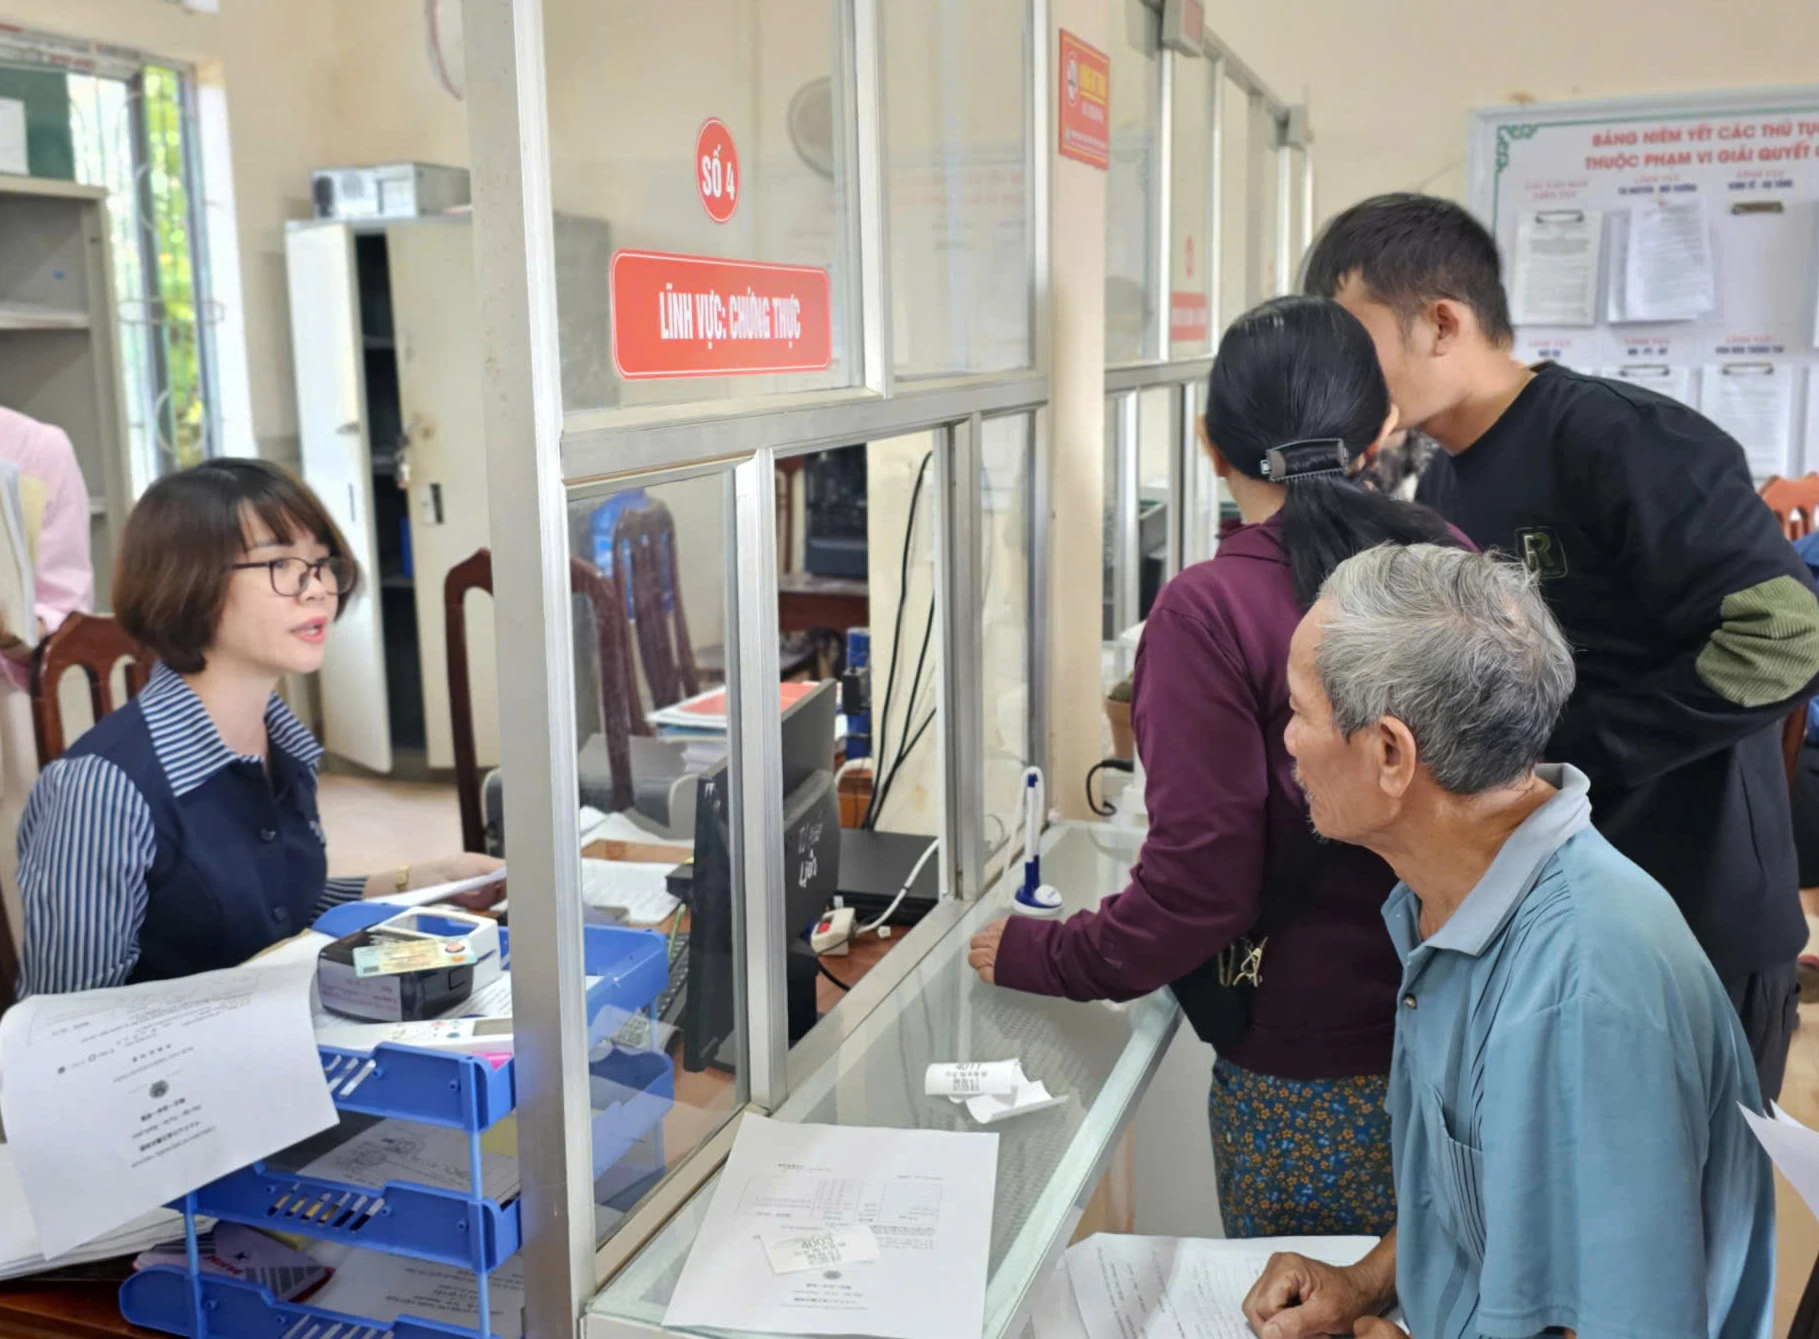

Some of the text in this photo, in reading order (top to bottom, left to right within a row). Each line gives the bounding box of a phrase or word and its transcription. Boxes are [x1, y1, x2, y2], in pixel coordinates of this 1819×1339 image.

[1591, 128, 1638, 147] BẢNG
[1687, 123, 1713, 141] YẾT
[1717, 121, 1756, 139] CÁC
[1762, 118, 1793, 138] THỦ
[702, 144, 735, 200] SỐ 4
[1584, 151, 1639, 171] THUỘC
[1643, 151, 1692, 169] PHẠM
[1697, 148, 1713, 165] VI
[1717, 144, 1754, 162] GIẢI
[1758, 141, 1810, 161] QUYẾT
[659, 282, 801, 350] LĨNH VỰC: CHỨNG THỰC
[1523, 532, 1555, 571] R
